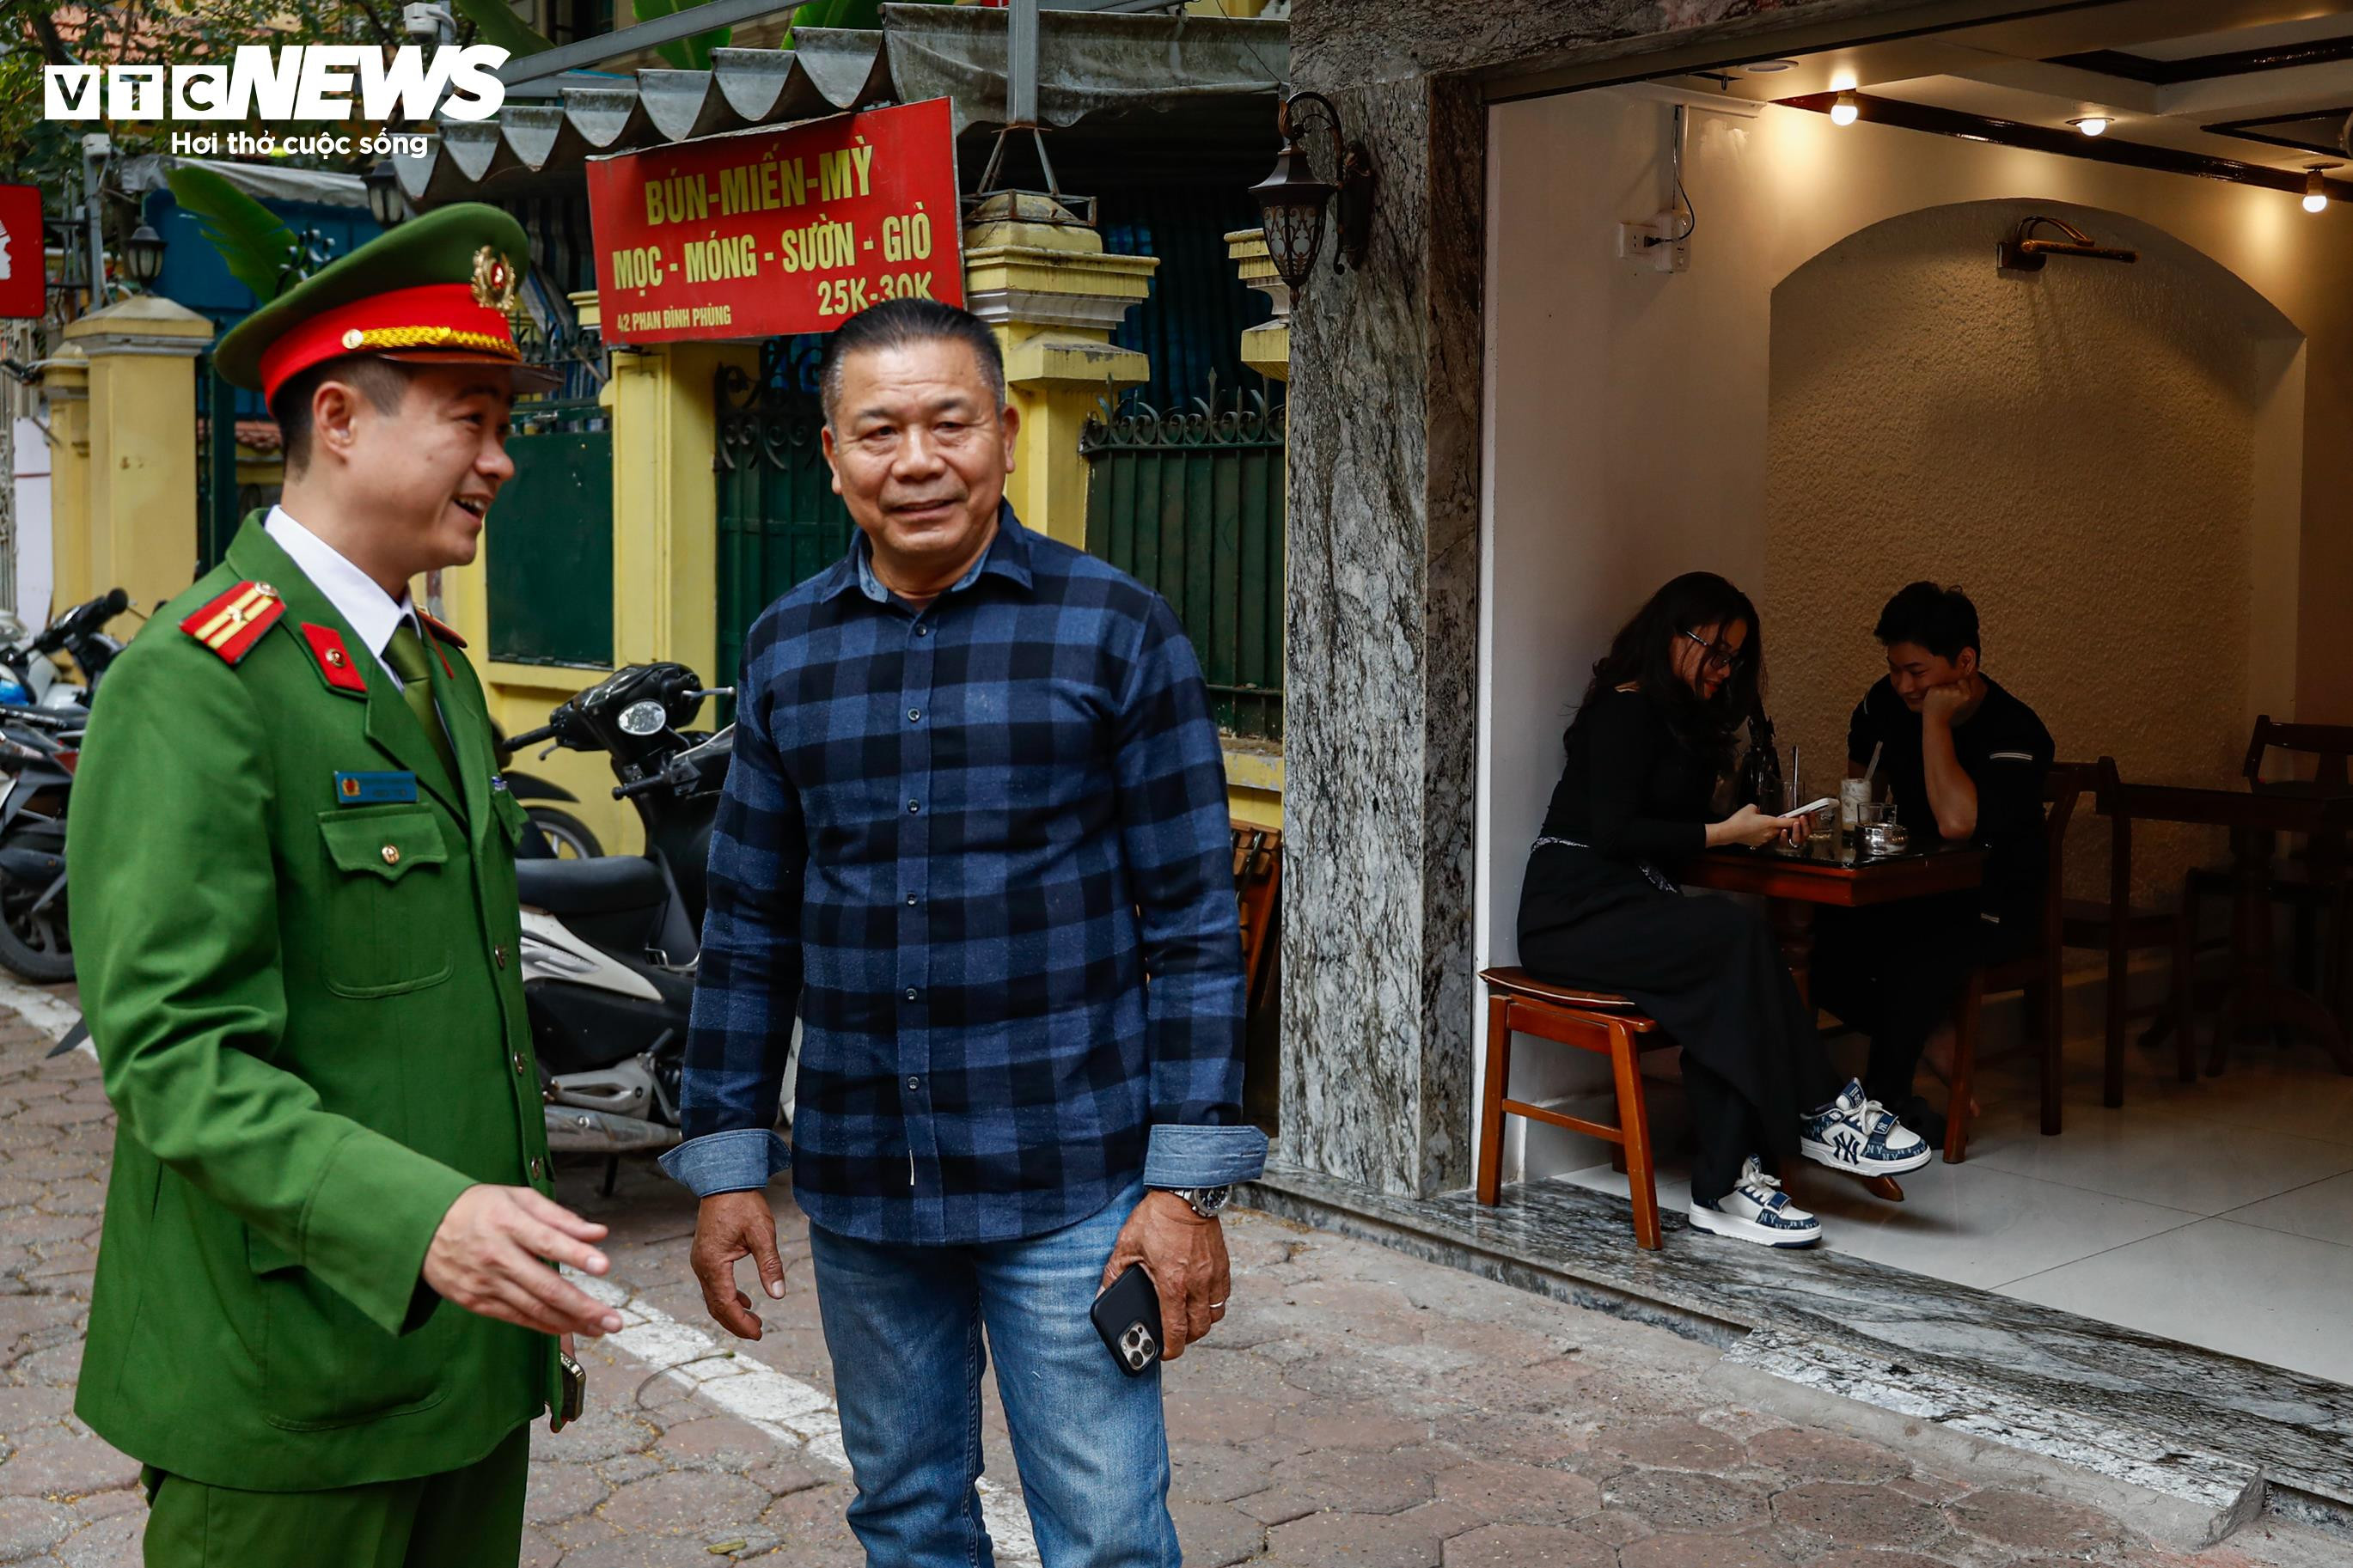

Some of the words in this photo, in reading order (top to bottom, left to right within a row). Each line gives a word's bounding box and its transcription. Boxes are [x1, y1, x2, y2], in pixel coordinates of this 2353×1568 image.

[612, 245, 663, 297] MỌC
[683, 229, 758, 284] MÓNG
[781, 213, 855, 274] SƯỜN
[882, 201, 932, 263] GIÒ
[617, 313, 631, 333] 42
[632, 310, 662, 331] PHAN
[1833, 1131, 1861, 1166] NY
